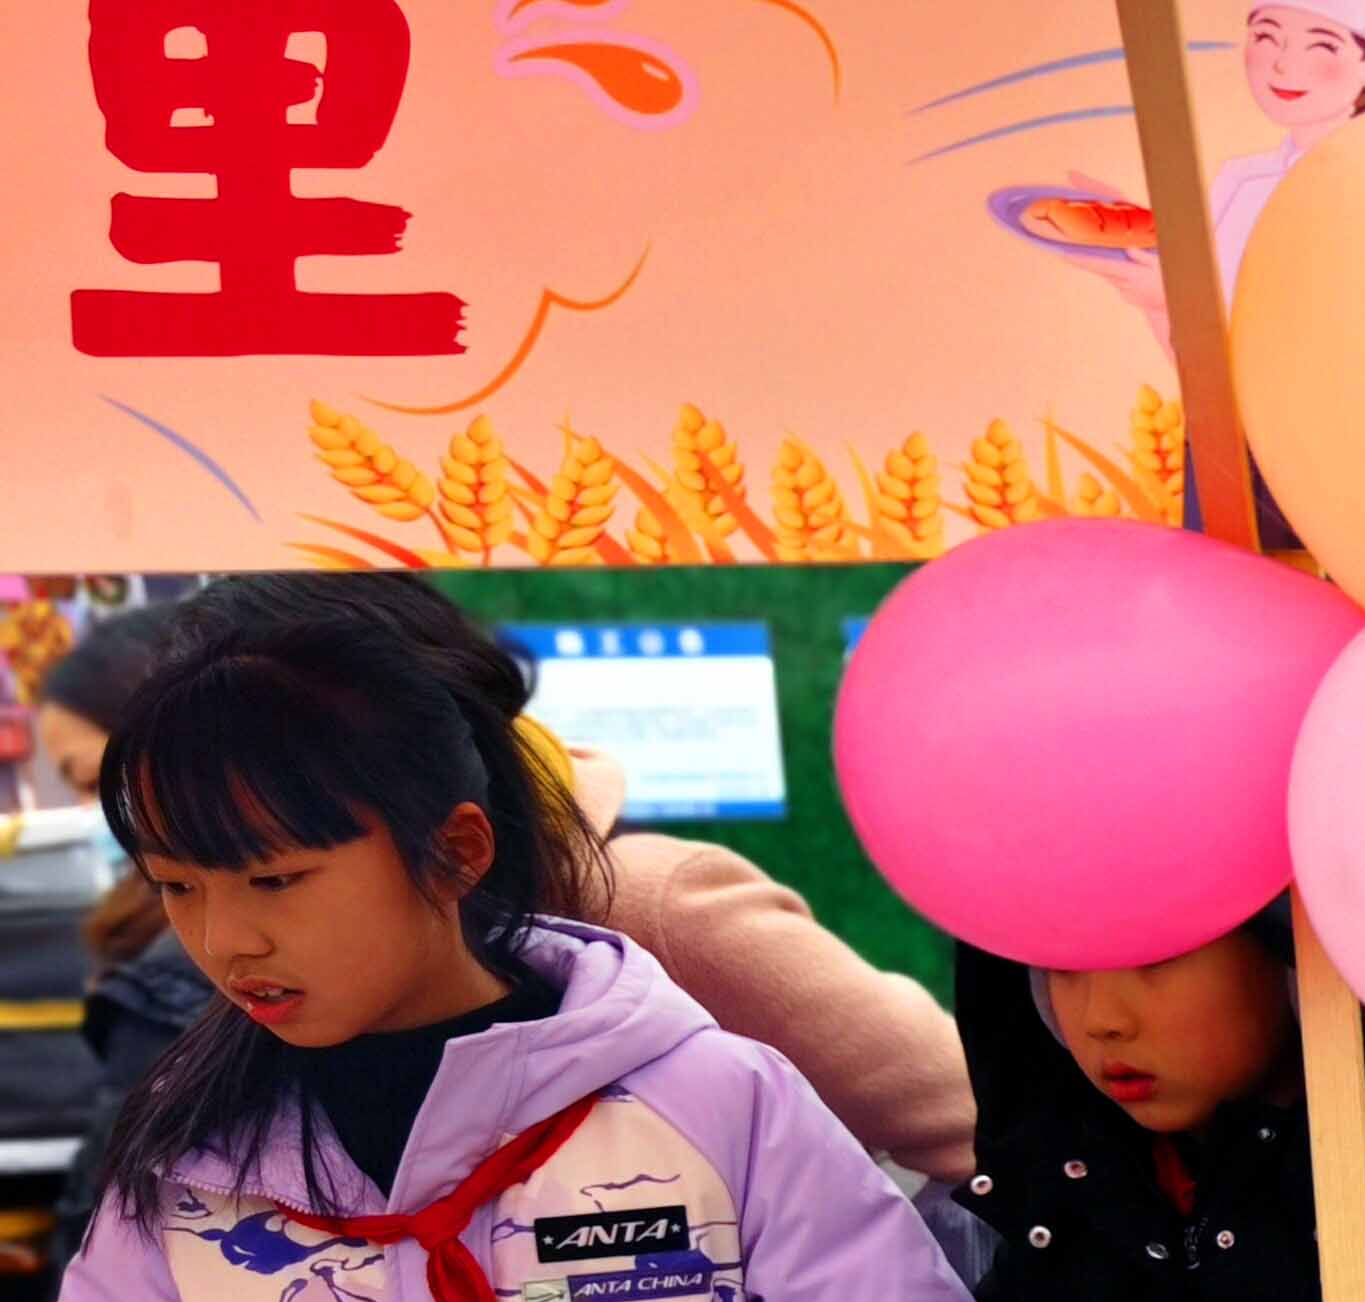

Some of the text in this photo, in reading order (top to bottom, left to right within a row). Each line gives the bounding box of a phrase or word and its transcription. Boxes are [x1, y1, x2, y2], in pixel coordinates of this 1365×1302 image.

[71, 0, 467, 357] 里
[555, 1217, 669, 1250] ANTA
[573, 1273, 703, 1298] ANTA CHINA
